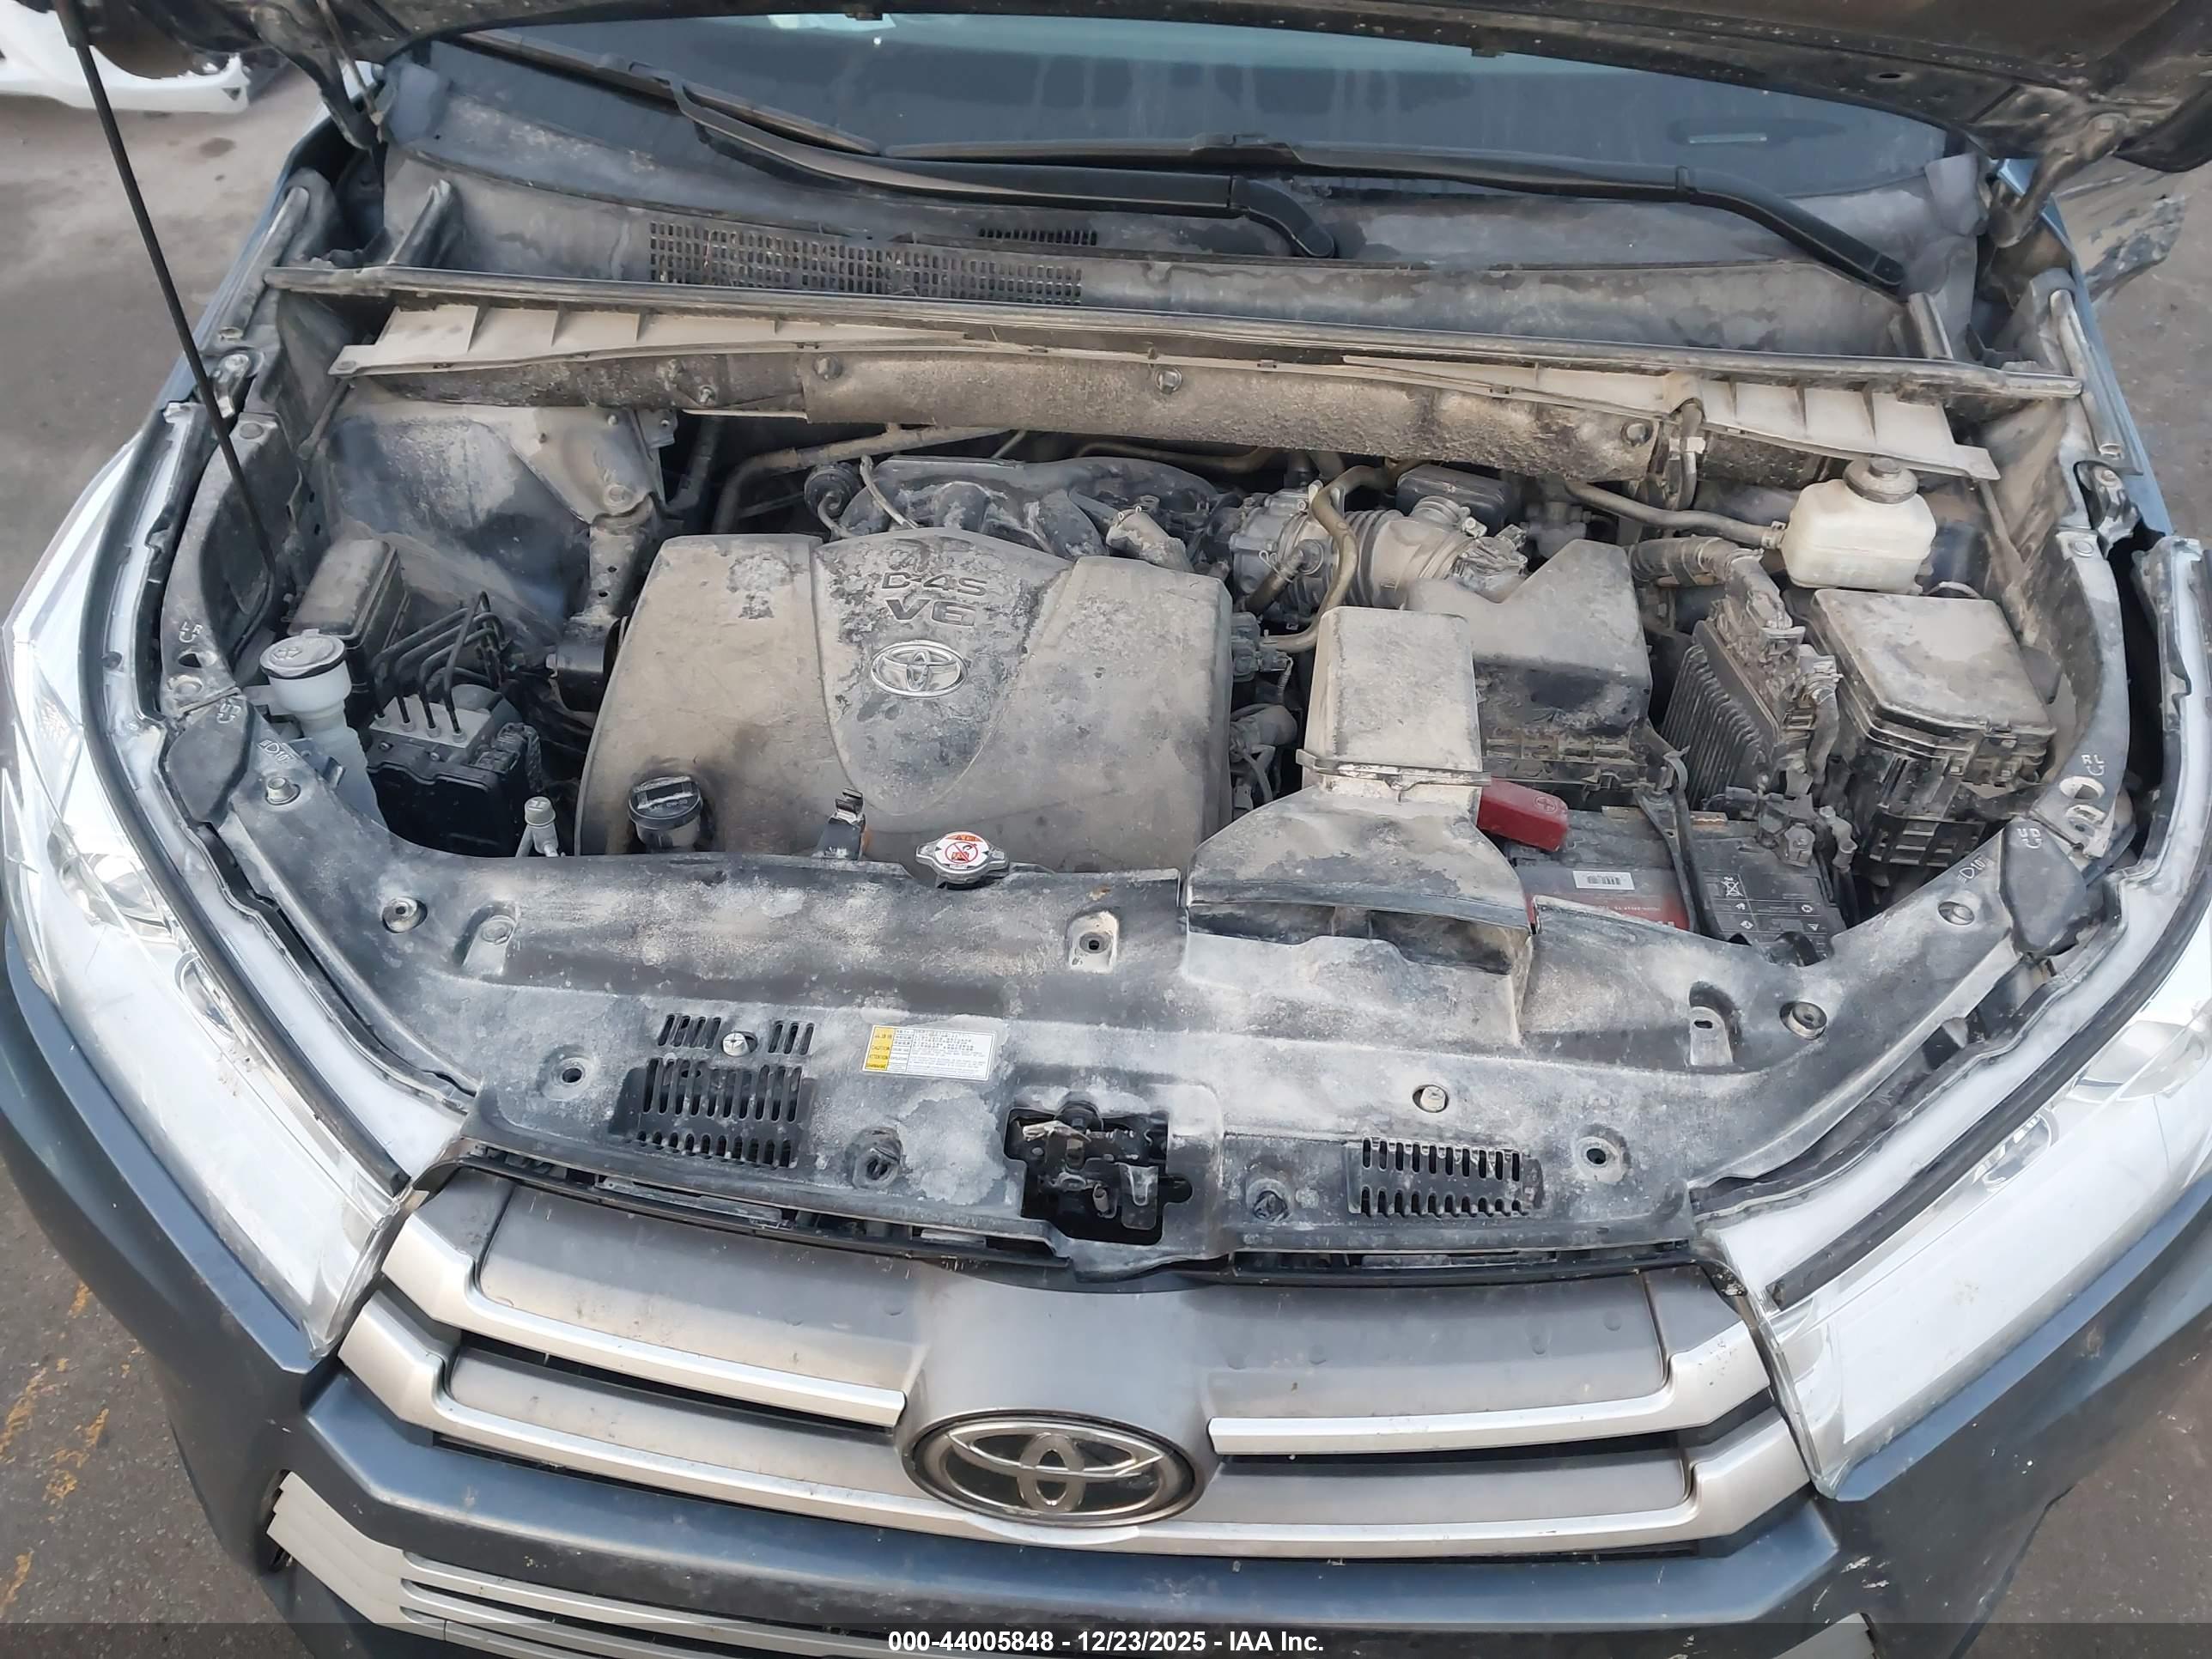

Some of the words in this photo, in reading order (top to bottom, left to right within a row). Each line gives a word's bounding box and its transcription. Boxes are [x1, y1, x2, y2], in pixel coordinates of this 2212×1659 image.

[2081, 754, 2093, 764] R
[2094, 754, 2105, 764] L
[2016, 828, 2028, 838] U
[2029, 828, 2041, 838] D
